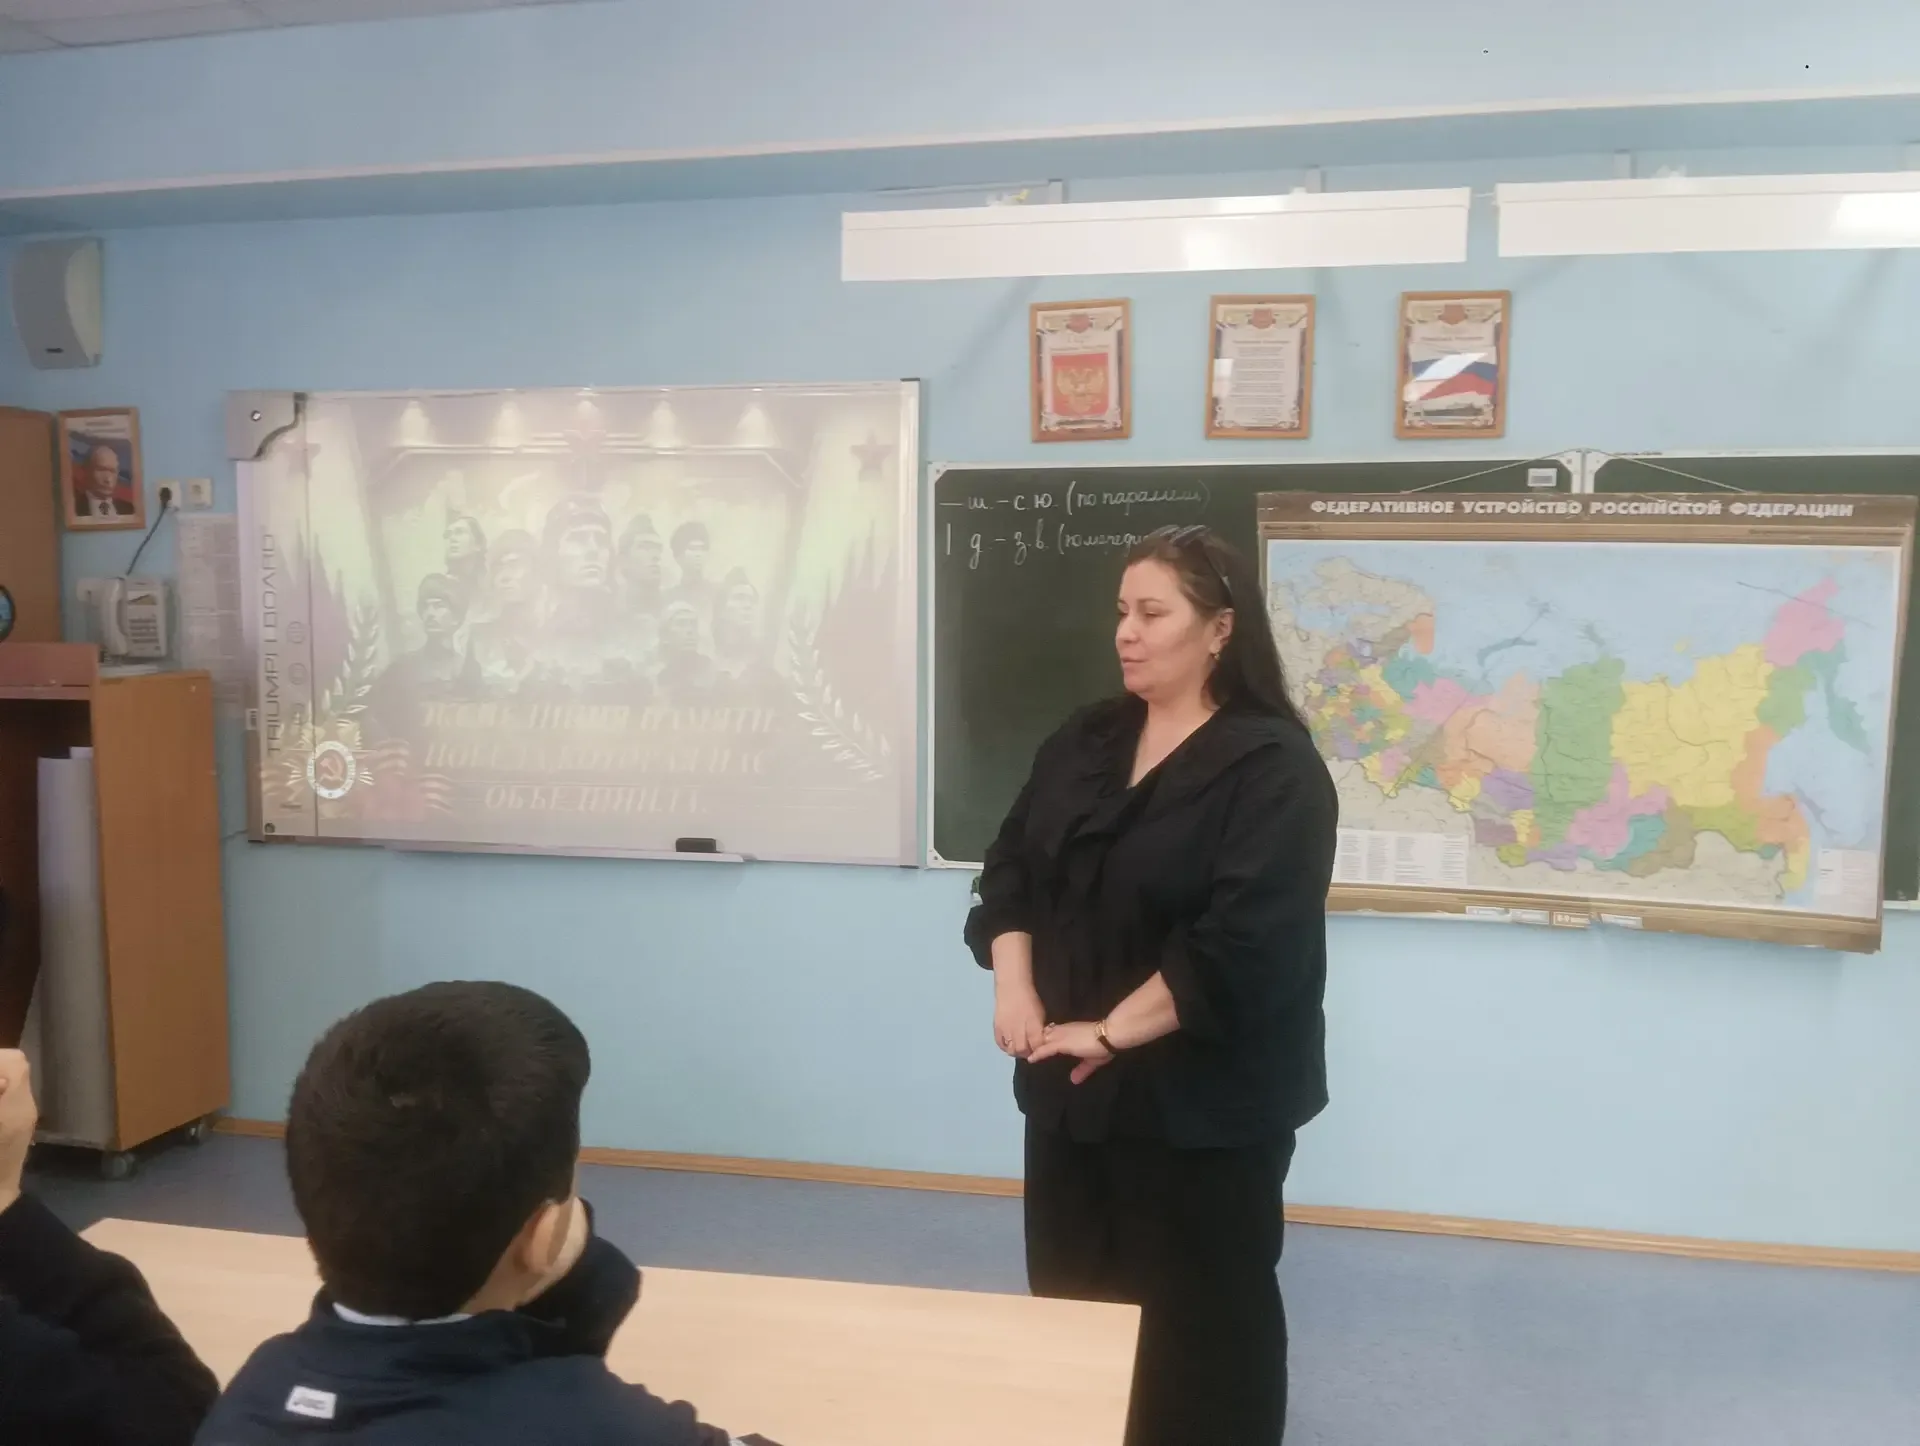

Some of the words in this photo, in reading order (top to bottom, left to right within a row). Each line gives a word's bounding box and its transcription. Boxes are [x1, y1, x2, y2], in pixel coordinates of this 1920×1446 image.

[1310, 500, 1455, 516] ФЕДЕРАТИВНОЕ
[1462, 498, 1583, 516] УСТРОЙСТВО
[1589, 499, 1722, 517] РОССИЙСКОЙ
[1729, 501, 1854, 519] ФЕДЕРАЦИИ
